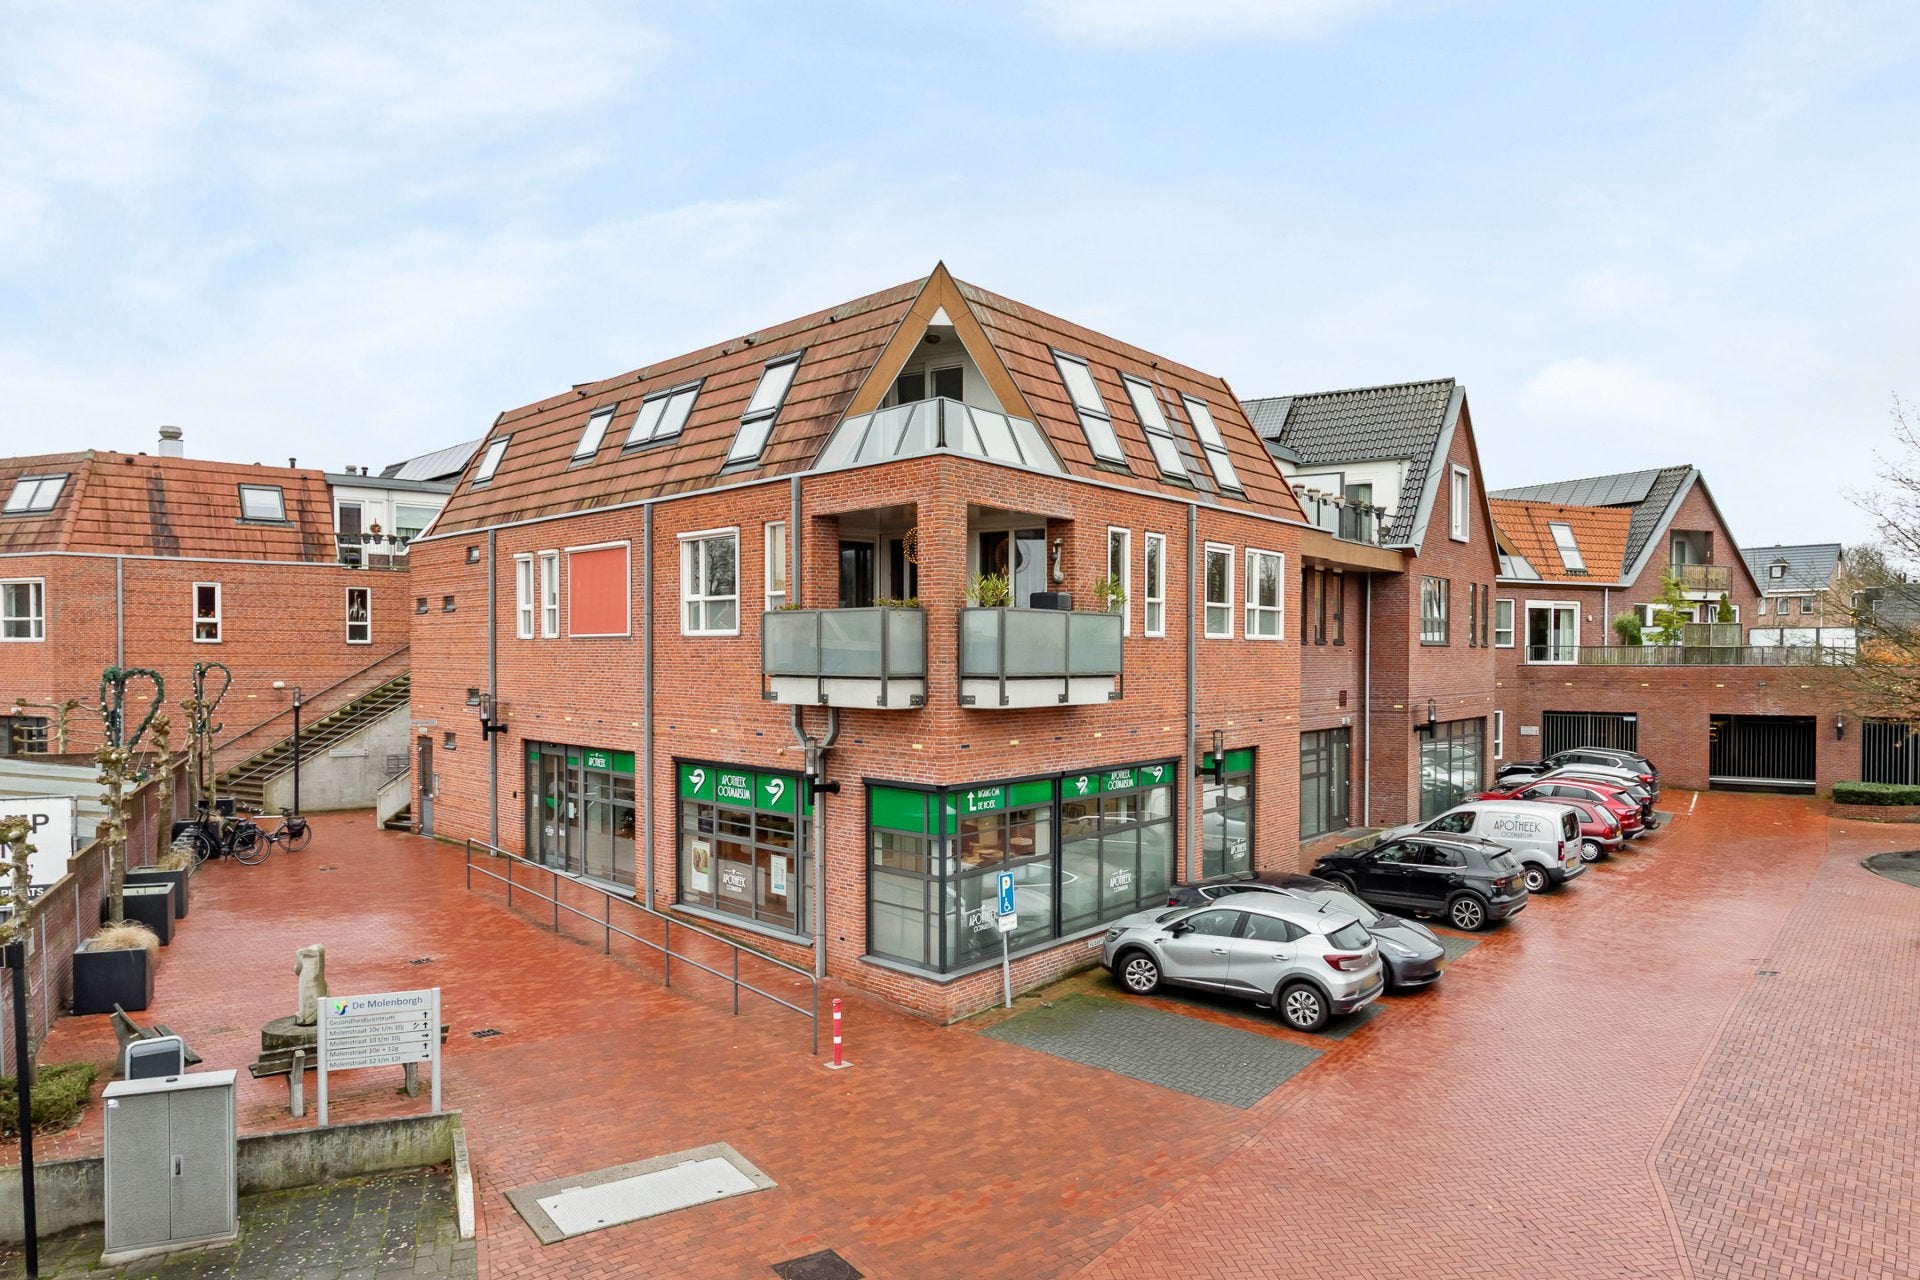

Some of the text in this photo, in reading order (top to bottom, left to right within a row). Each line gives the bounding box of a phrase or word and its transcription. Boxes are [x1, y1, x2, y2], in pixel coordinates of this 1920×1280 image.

[721, 774, 747, 788] APOTHEEK
[717, 785, 751, 800] OOTMARSUM
[1494, 819, 1542, 833] APOTHEEK
[1002, 876, 1011, 897] P
[352, 996, 423, 1010] De Molenborgh
[329, 1028, 367, 1037] Molenstraat
[329, 1038, 367, 1047] Molenstraat
[329, 1048, 367, 1057] Molenstraat
[329, 1058, 367, 1068] Molenstraat
